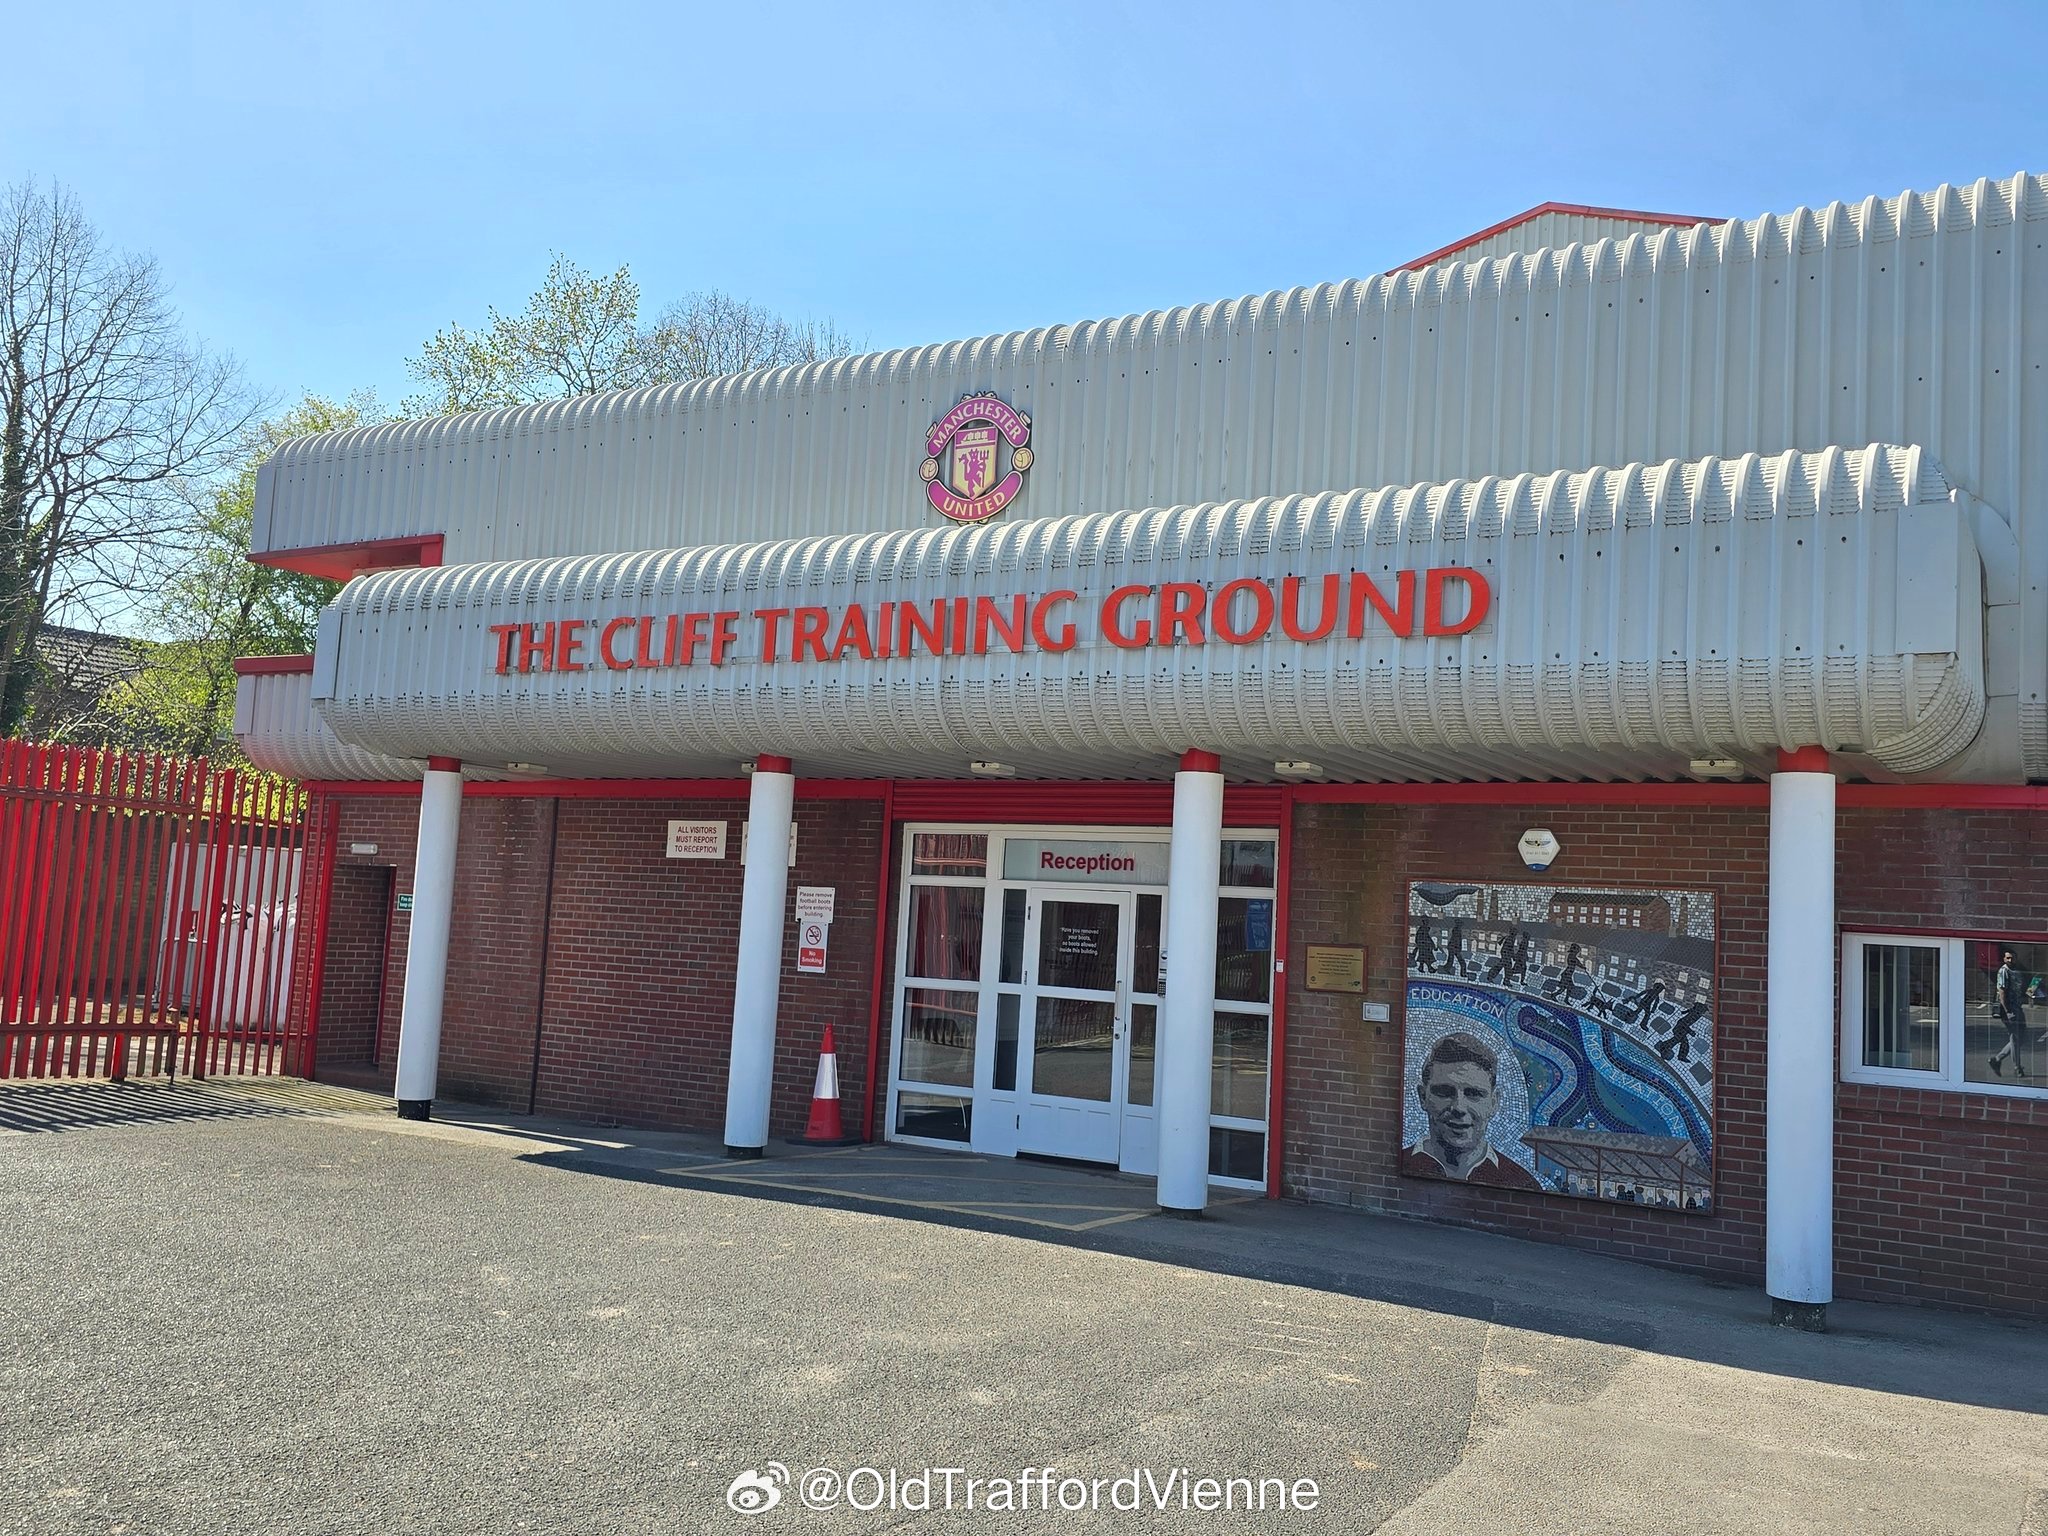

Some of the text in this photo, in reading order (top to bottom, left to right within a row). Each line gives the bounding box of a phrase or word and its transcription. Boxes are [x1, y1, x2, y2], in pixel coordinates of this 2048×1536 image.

[933, 402, 1021, 448] MANCHESTER
[943, 491, 1005, 516] UNITED
[489, 567, 1491, 674] THE CLIFF TRAINING GROUND
[675, 835, 718, 844] MUST REPORT
[677, 826, 717, 834] ALL VISITORS
[684, 845, 718, 853] RECEPTION
[1041, 851, 1135, 874] Reception
[802, 956, 823, 965] Smoking
[1411, 988, 1504, 1018] EDUCATION
[1585, 1033, 1685, 1131] MOTIVATION
